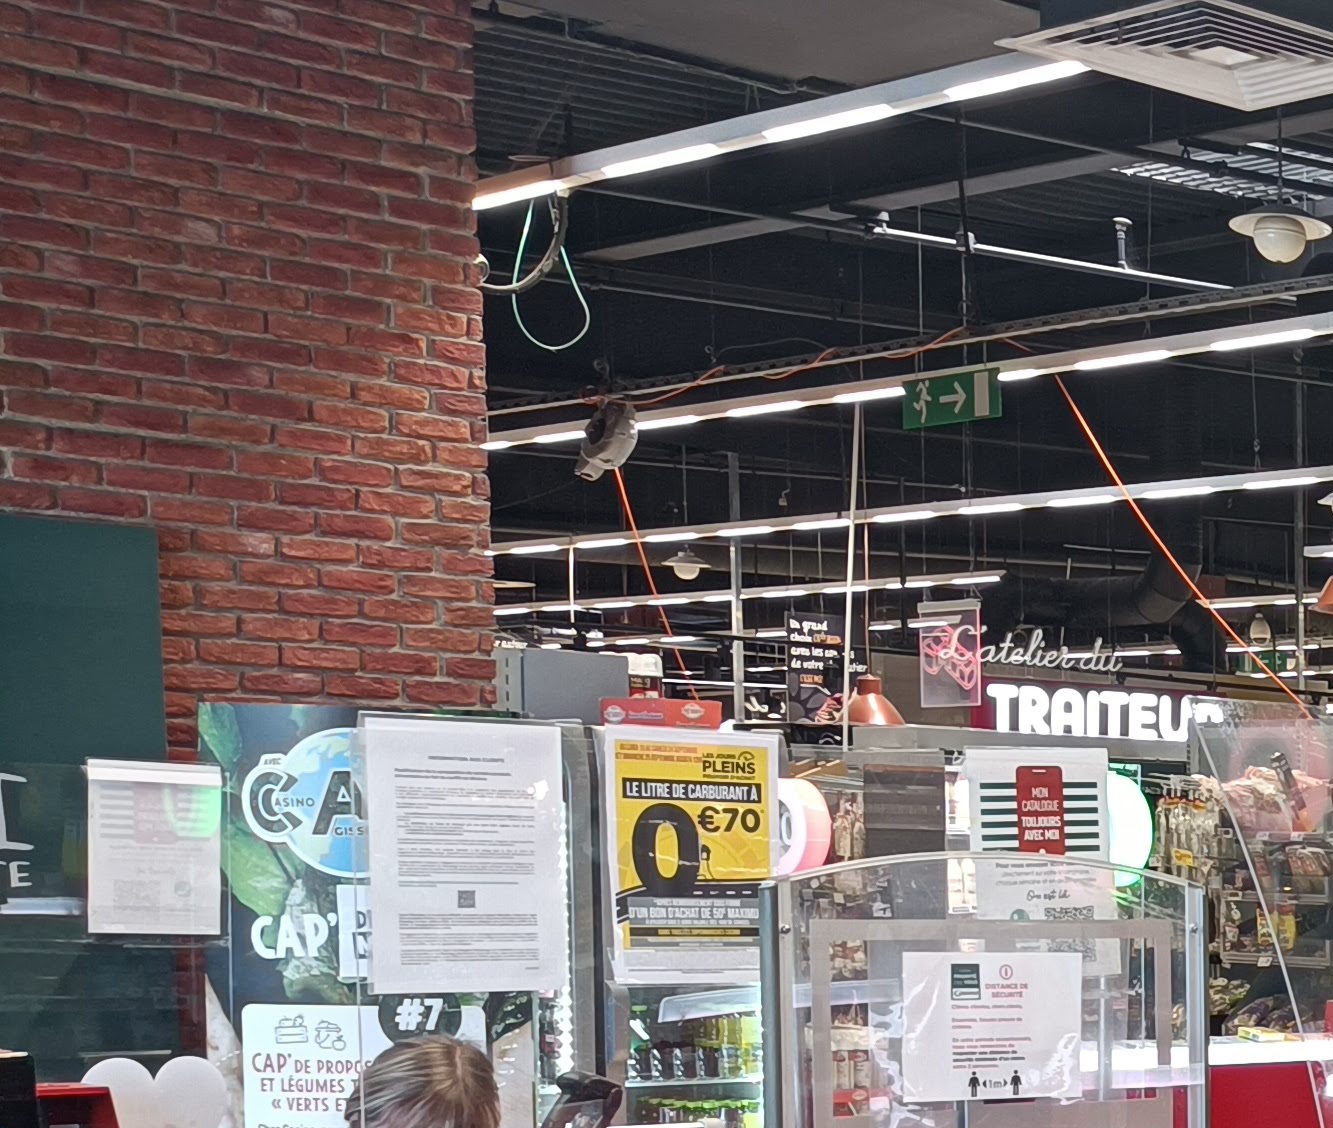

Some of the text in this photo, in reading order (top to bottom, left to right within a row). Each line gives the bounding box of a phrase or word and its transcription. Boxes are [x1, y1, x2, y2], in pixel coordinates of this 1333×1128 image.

[940, 625, 1123, 672] L'atelier du
[702, 760, 756, 775] PLEINS
[626, 782, 640, 797] LE
[641, 782, 671, 798] LITRE
[672, 784, 687, 798] DE
[687, 785, 748, 800] CARBURANT
[251, 912, 338, 960] CAP'
[395, 998, 444, 1032] #7
[294, 1061, 311, 1074] DE
[316, 1060, 373, 1075] PROPOS
[261, 1078, 275, 1093] ET
[280, 1074, 346, 1094] LÉGUMES
[285, 1098, 330, 1112] VERTS
